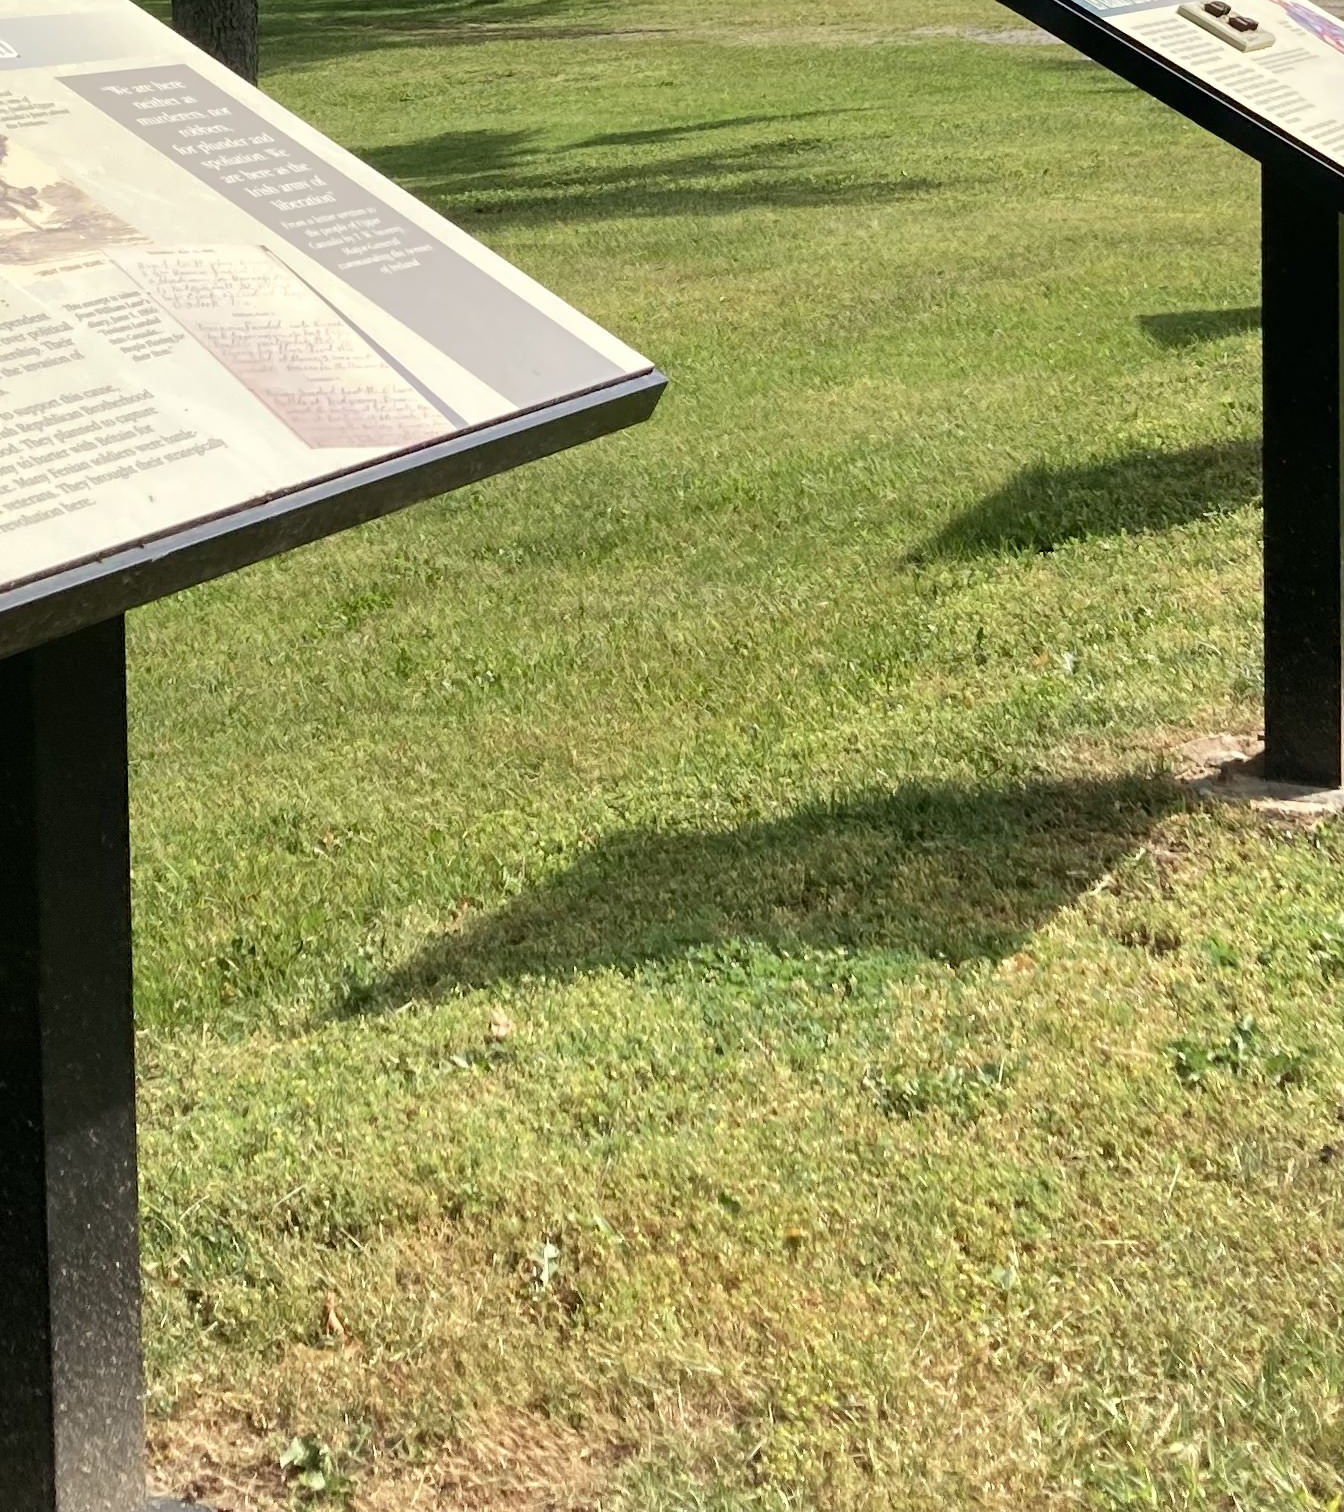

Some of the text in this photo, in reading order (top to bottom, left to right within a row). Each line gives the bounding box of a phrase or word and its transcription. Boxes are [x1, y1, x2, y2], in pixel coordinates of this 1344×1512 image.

[0, 333, 27, 345] over
[26, 321, 74, 341] political
[40, 337, 75, 351] Their
[0, 367, 23, 378] the
[20, 355, 72, 372] invasion
[13, 399, 62, 417] support
[59, 393, 85, 405] this
[15, 410, 84, 433] Republican
[80, 389, 154, 415] Brotherhood
[19, 436, 55, 450] They
[53, 420, 103, 444] planned
[115, 407, 159, 424] capture
[28, 449, 70, 466] barter
[68, 440, 98, 454] with
[94, 430, 137, 447] Britain
[132, 424, 155, 436] for
[12, 473, 51, 489] Many
[47, 461, 92, 479] Fenian
[90, 448, 137, 466] soldiers
[134, 439, 165, 452] were
[55, 479, 91, 494] They
[85, 465, 138, 485] brought
[135, 457, 164, 471] their
[58, 498, 97, 513] here.
